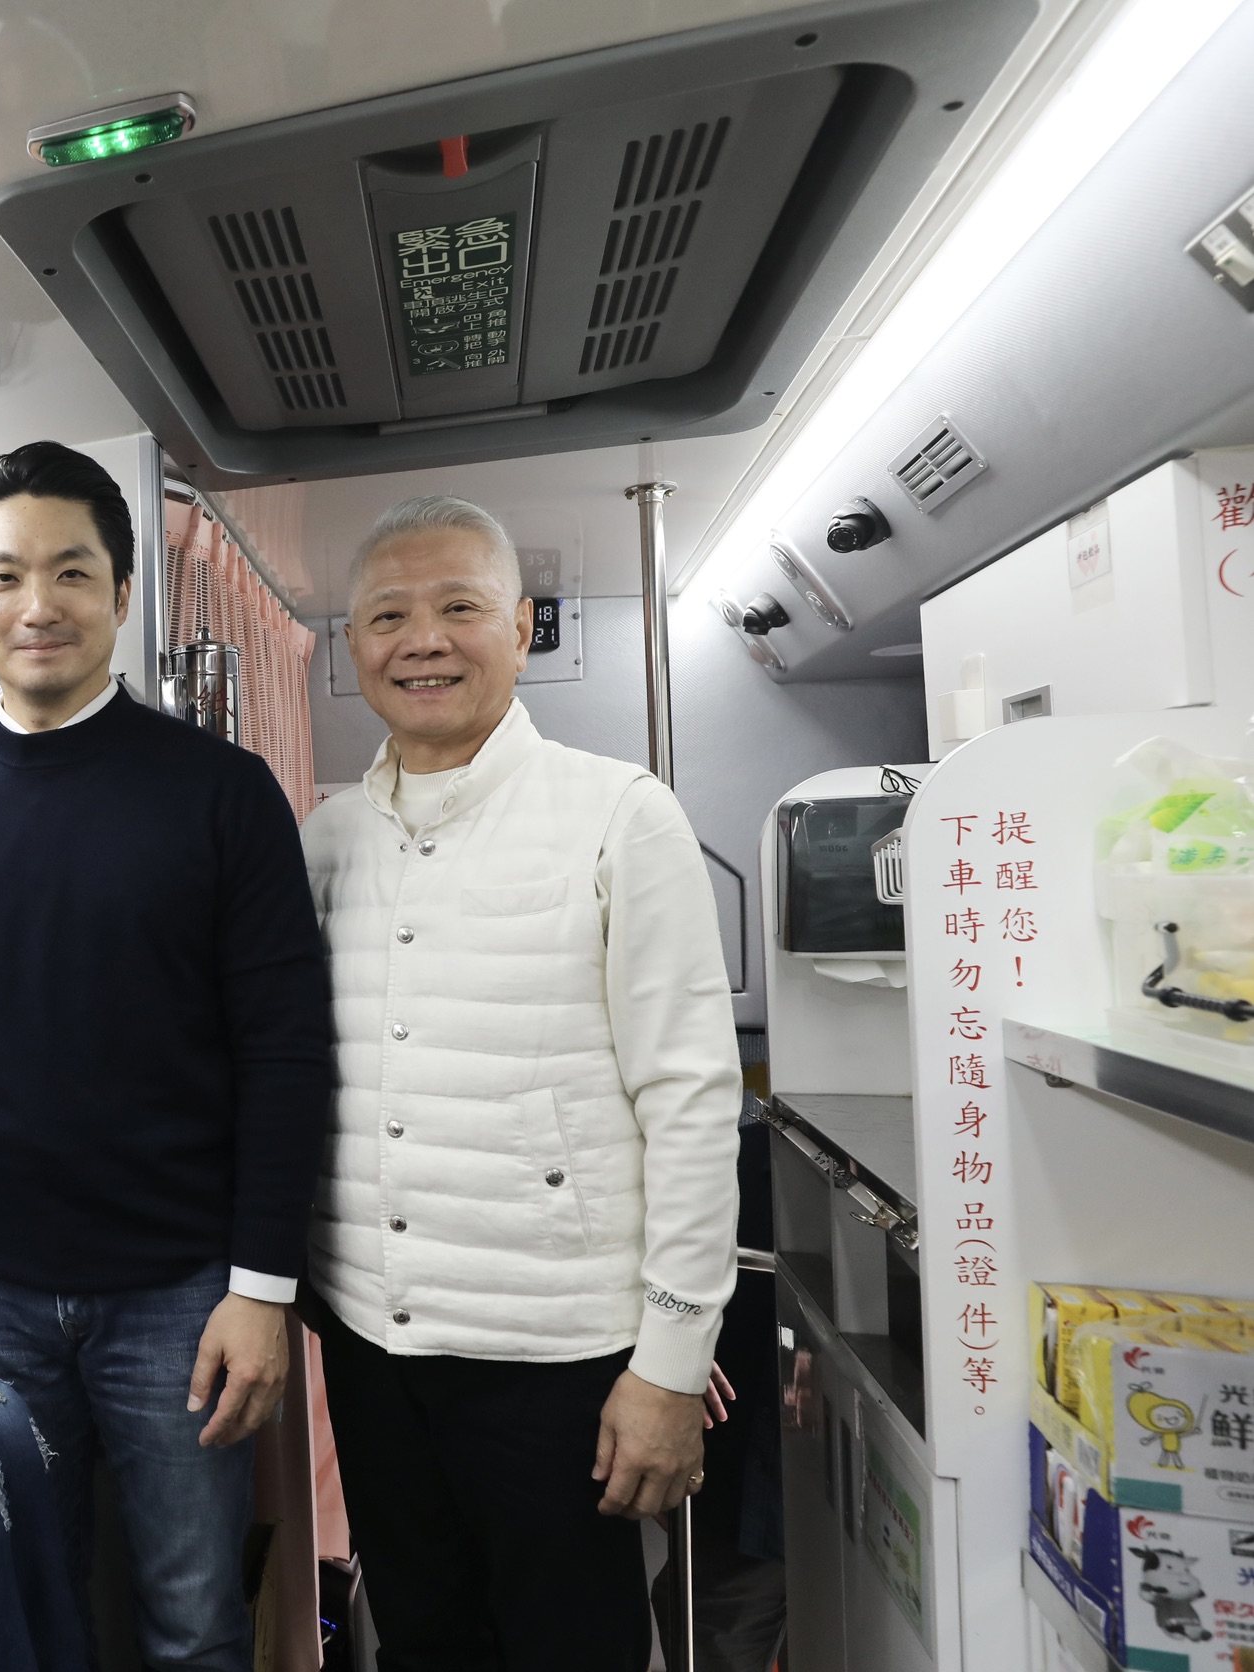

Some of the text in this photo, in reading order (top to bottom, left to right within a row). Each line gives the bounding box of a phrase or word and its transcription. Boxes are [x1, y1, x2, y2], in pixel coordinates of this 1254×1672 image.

[398, 217, 510, 256] 緊急
[402, 241, 508, 278] 出口
[400, 265, 512, 288] Emergency
[462, 277, 504, 291] Exit
[403, 286, 508, 309] 車頂逃生口
[538, 606, 553, 621] 18
